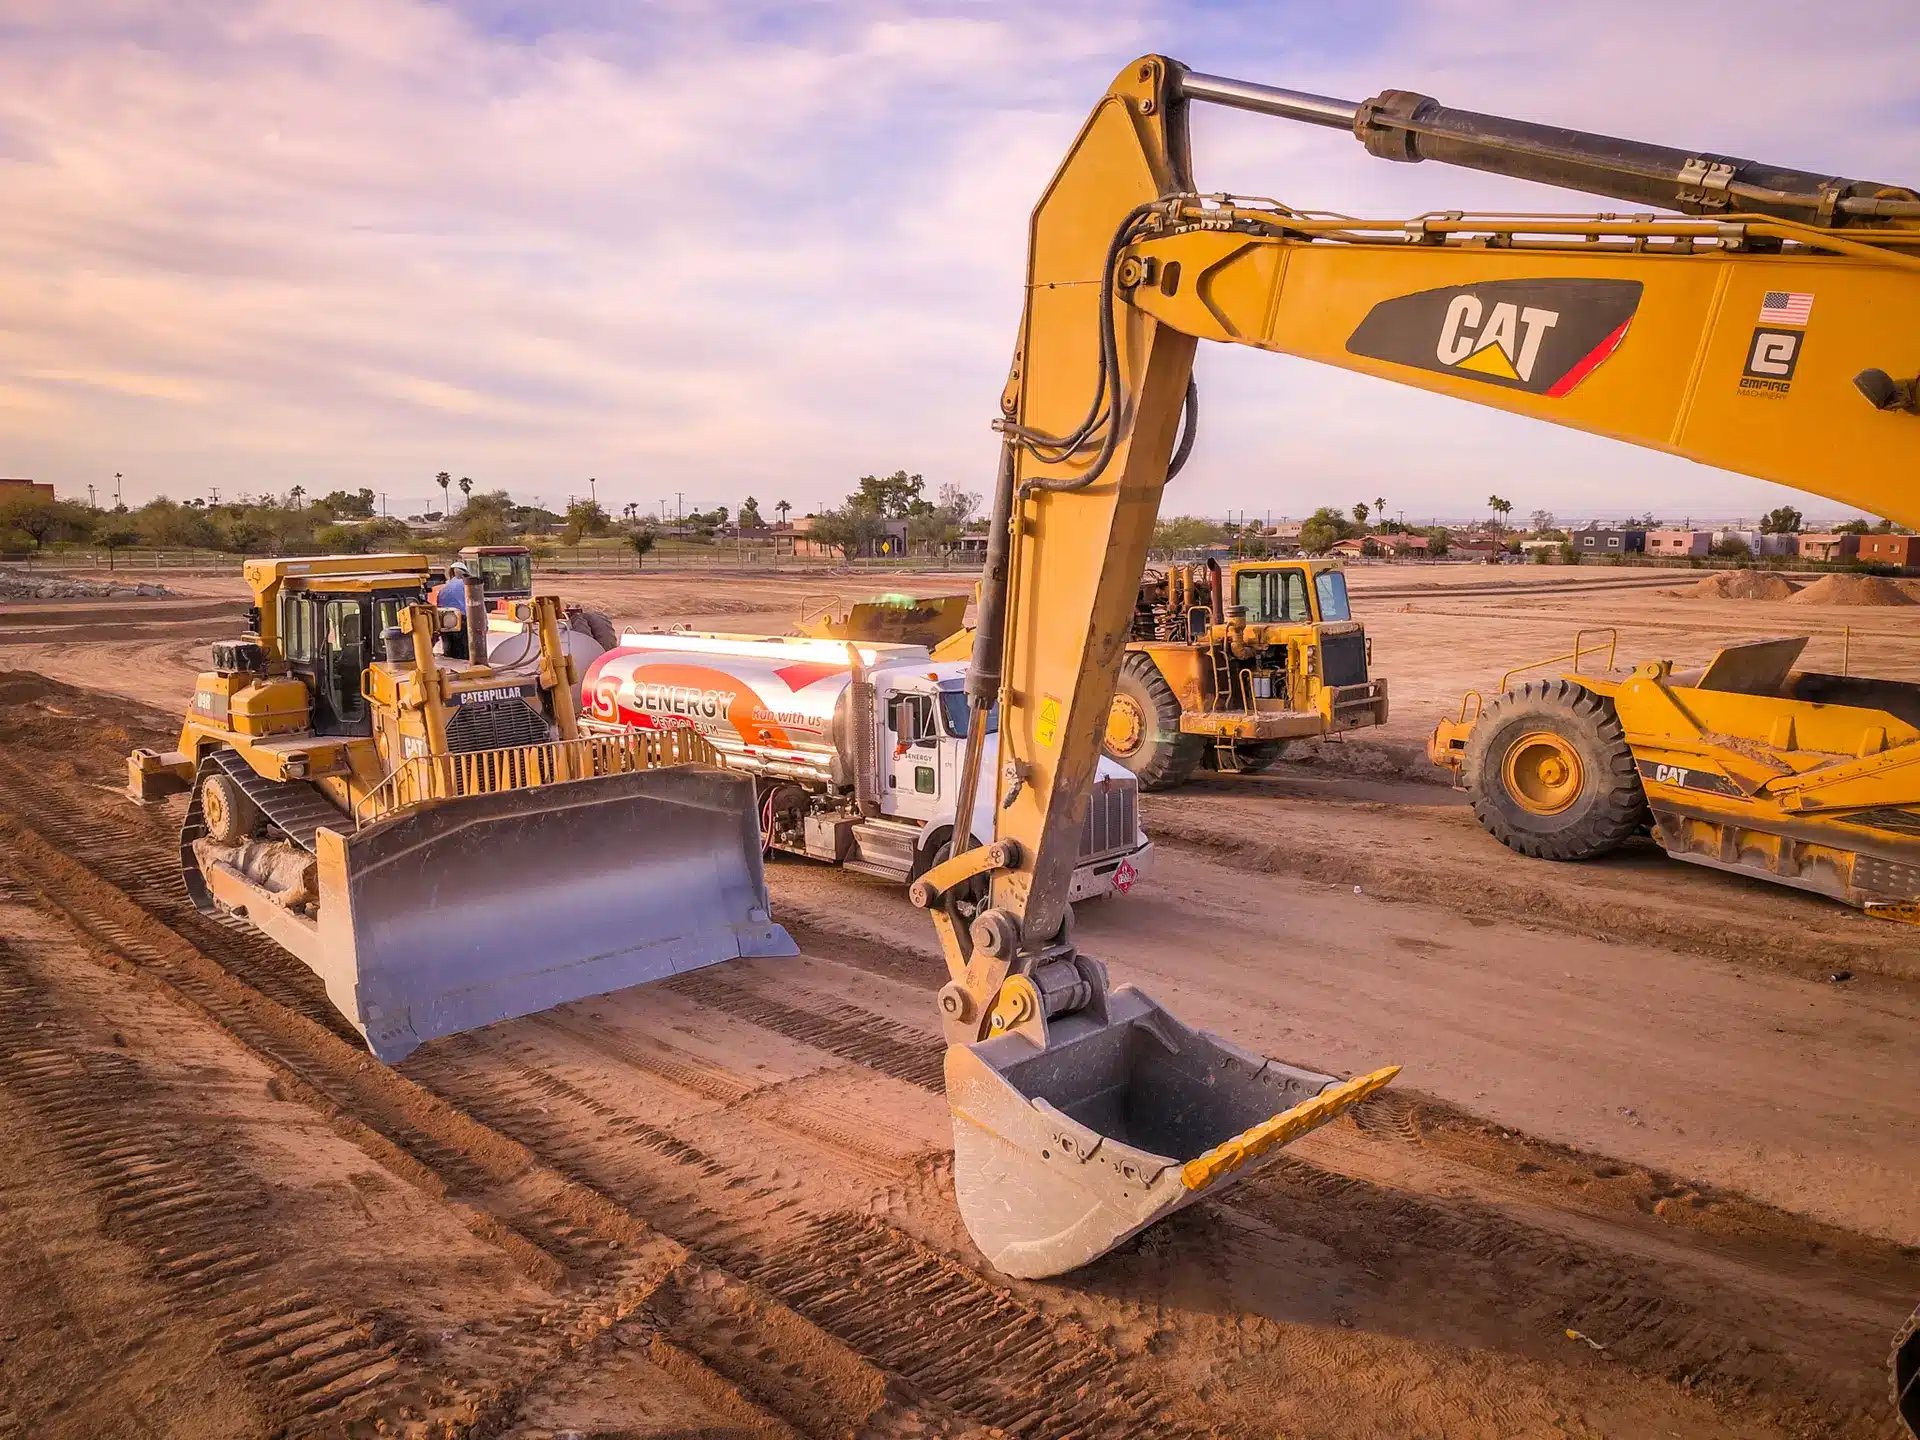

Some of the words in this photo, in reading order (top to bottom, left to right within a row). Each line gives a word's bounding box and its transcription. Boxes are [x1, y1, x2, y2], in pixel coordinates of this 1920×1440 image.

[1436, 294, 1559, 382] CAT
[1736, 387, 1788, 400] MACHINERY
[460, 686, 521, 704] CATERPILLAR
[633, 683, 737, 720] SENERGY
[752, 704, 775, 722] Run
[778, 710, 805, 725] with
[808, 715, 823, 727] us
[404, 736, 423, 759] CAT
[904, 754, 933, 762] SENERGY
[1656, 764, 1688, 788] CAT
